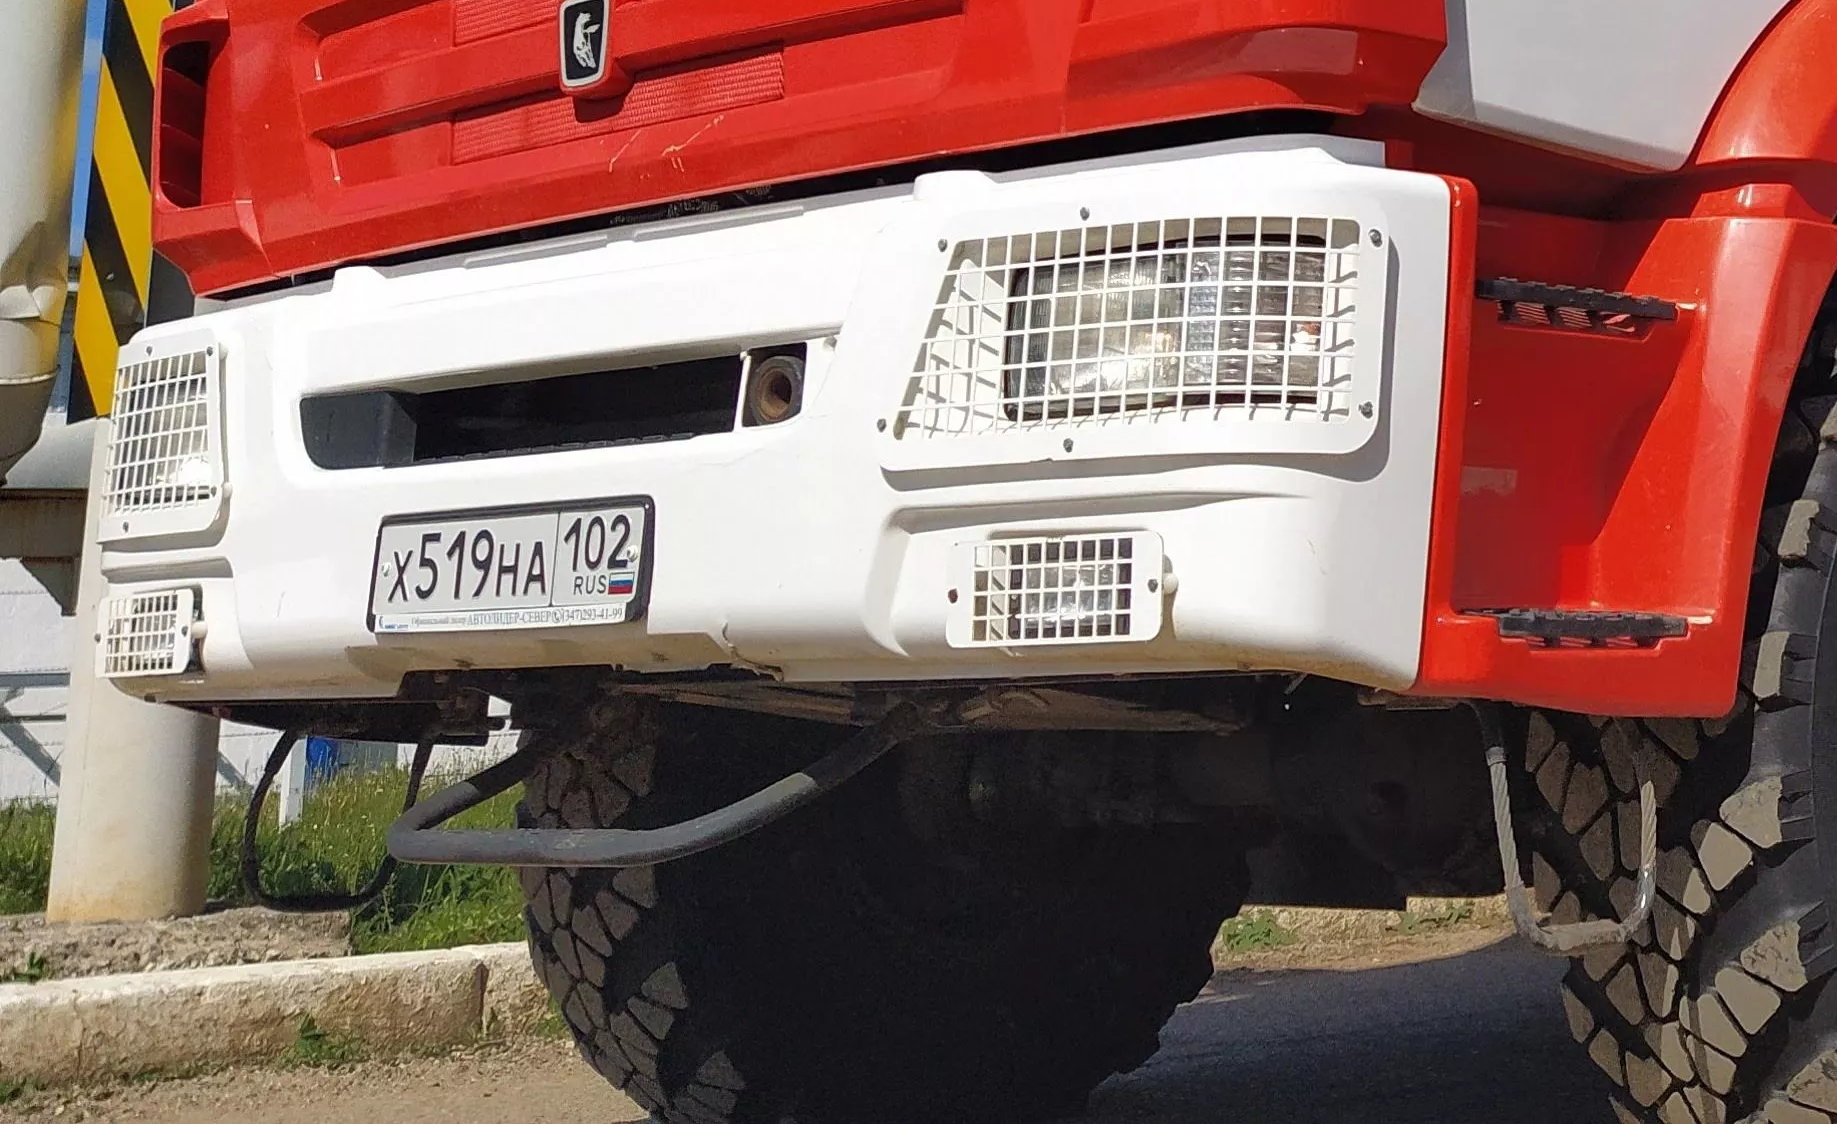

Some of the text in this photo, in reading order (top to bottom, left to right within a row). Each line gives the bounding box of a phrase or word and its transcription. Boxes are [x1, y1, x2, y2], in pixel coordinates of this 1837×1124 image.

[387, 513, 631, 604] Х519НА 102
[573, 575, 606, 595] RUS
